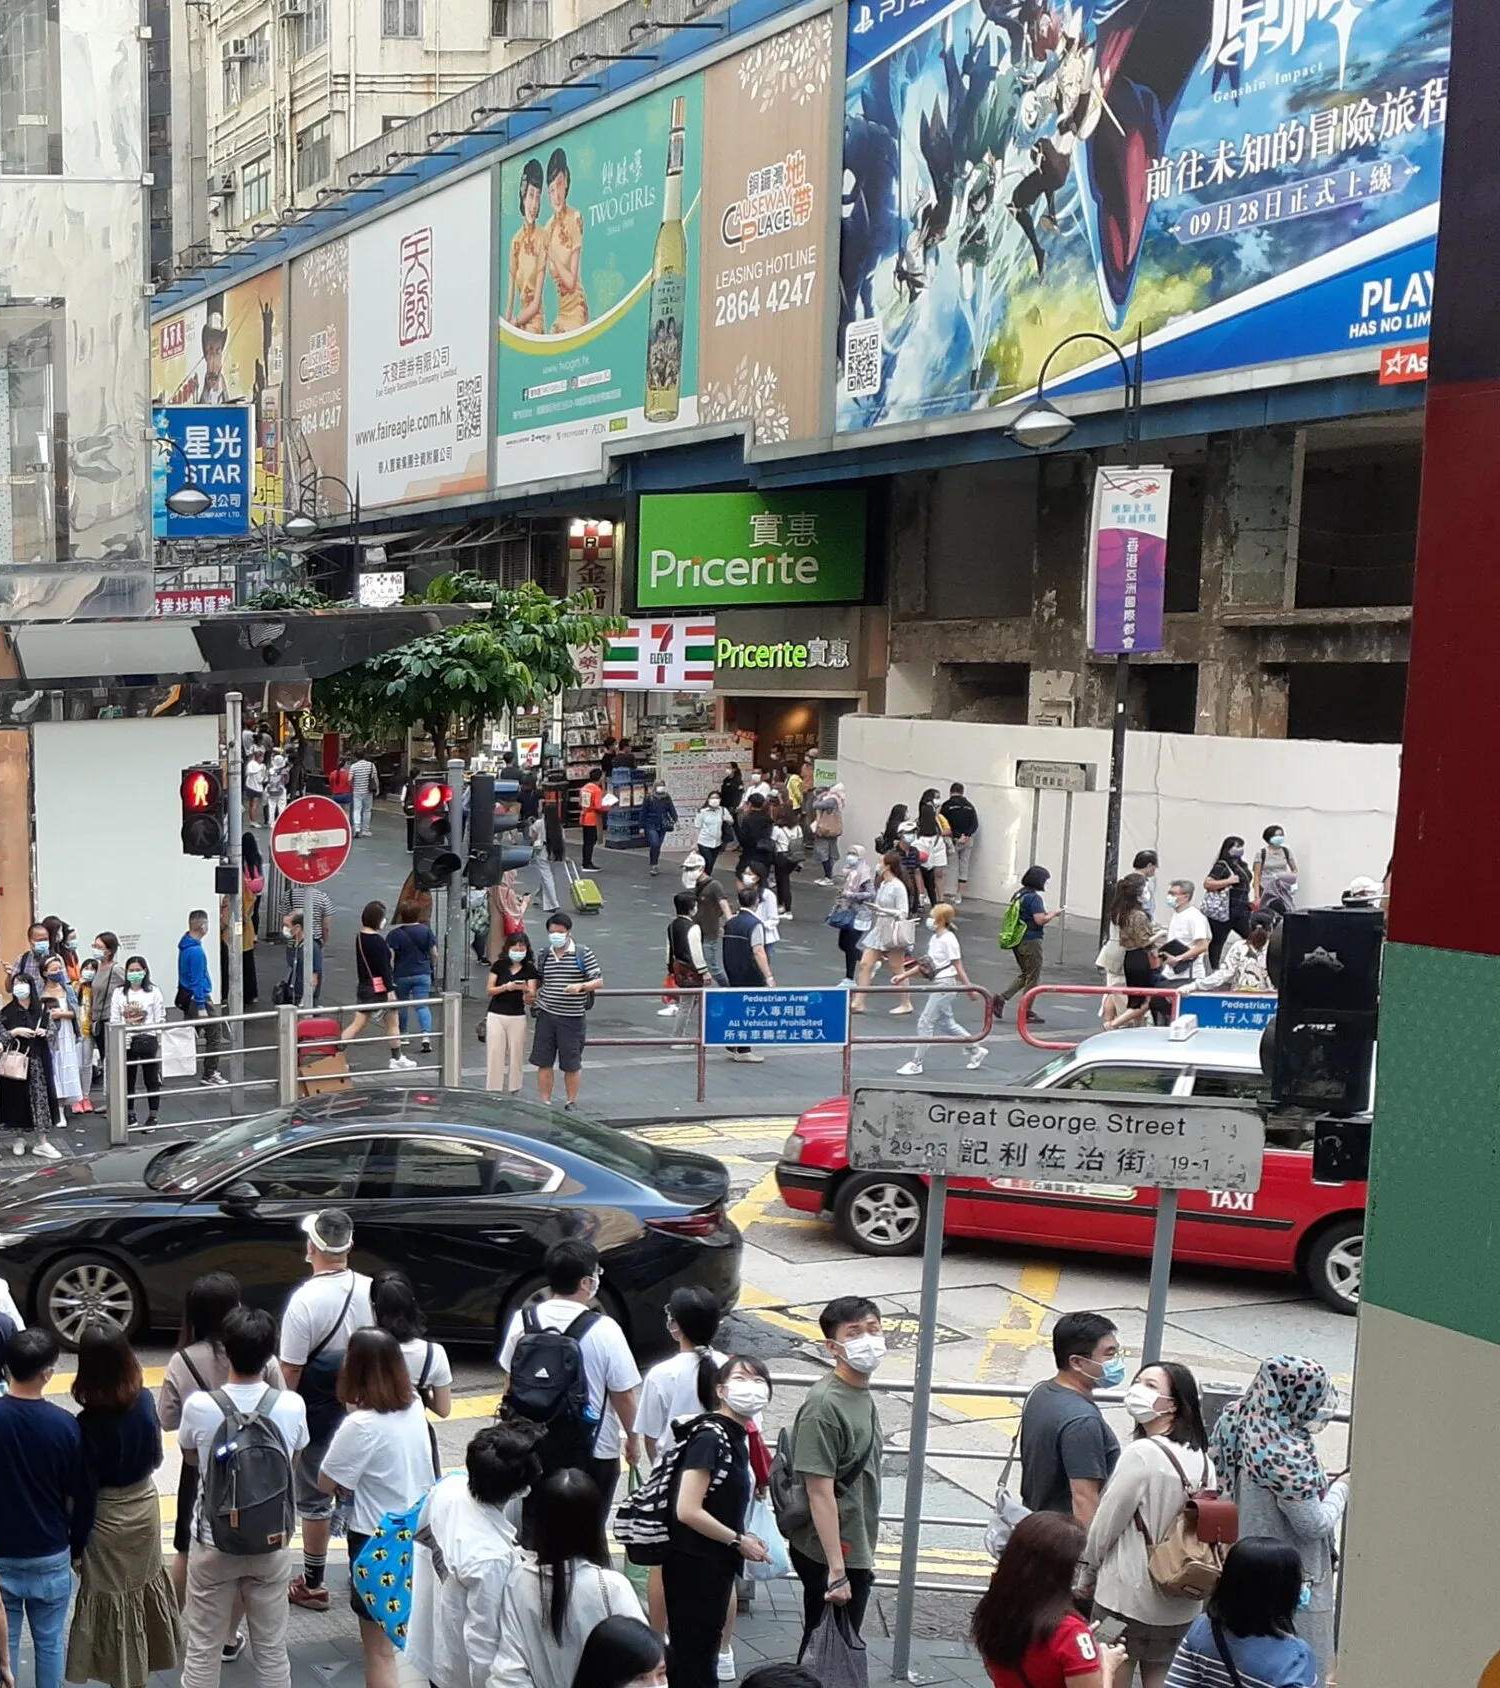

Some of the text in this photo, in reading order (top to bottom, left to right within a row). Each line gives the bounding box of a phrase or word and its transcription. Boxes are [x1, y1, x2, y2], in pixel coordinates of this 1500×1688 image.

[1213, 62, 1324, 104] Genshin Impact
[1145, 77, 1449, 203] 前往未知的冒險旅程
[588, 197, 618, 227] TWO
[741, 208, 791, 252] PLACE
[716, 262, 763, 290] LEASING
[766, 246, 816, 275] HOTLINE
[715, 286, 761, 327] 2864
[766, 272, 816, 313] 4247
[1349, 321, 1377, 339] HAS
[1380, 316, 1402, 333] NO
[319, 405, 342, 430] 4247
[355, 405, 452, 445] www.faireagle.com.hk
[185, 426, 241, 459] 星光
[186, 464, 241, 485] STAR
[749, 511, 819, 547] 實惠
[651, 550, 819, 588] Pricerite
[1122, 537, 1140, 650] 香港亞洲國際都會
[717, 636, 850, 668] Pricerite 實惠
[743, 994, 786, 1002] Pedestrian
[745, 1006, 806, 1017] 行人專用區
[1221, 1000, 1271, 1010] Pedestrian
[724, 1029, 827, 1040] 所有車輛禁止駛入
[781, 1018, 823, 1026] Prohibited
[928, 1104, 1186, 1136] Great George Street
[961, 1138, 1145, 1174] 記利佐治街
[1208, 1190, 1254, 1211] TAXI
[1076, 1632, 1097, 1660] 8
